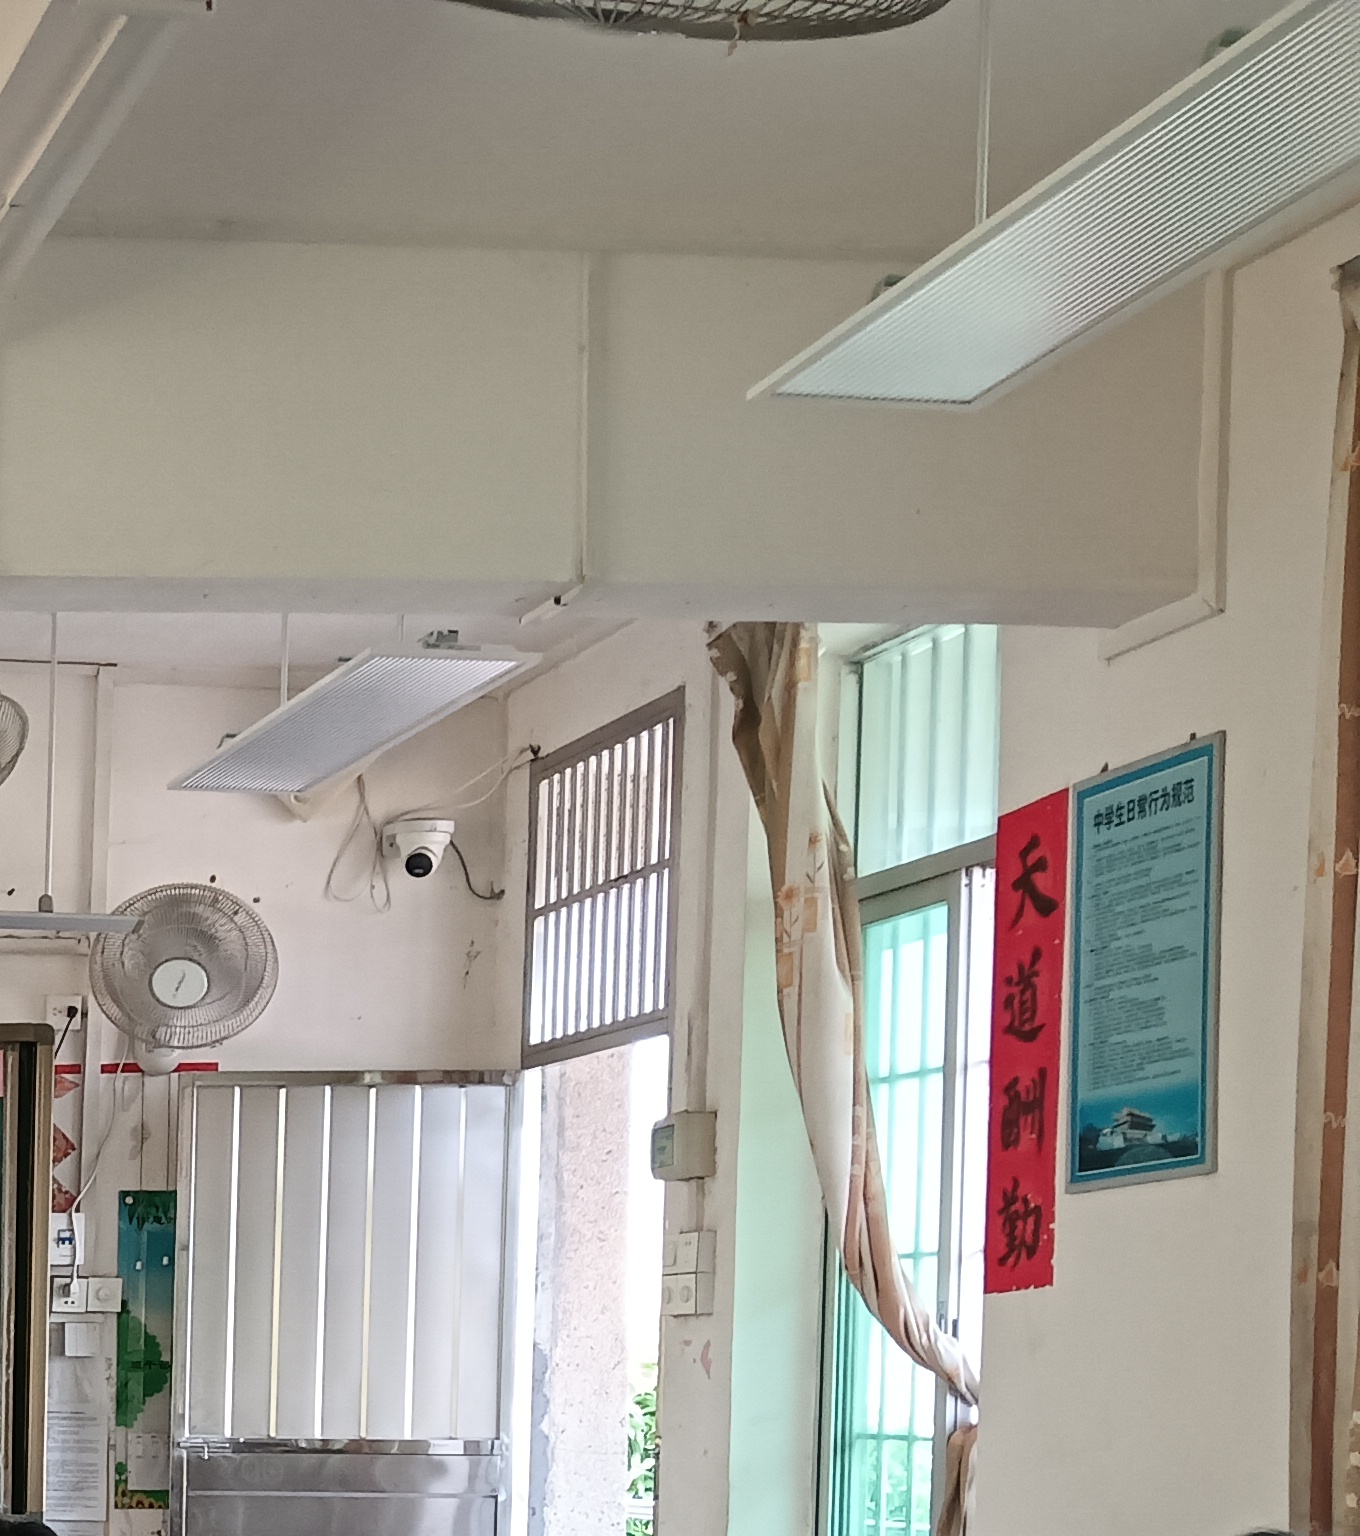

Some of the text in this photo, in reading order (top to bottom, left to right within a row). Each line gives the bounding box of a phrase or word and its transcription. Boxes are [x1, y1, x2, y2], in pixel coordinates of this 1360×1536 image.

[1093, 777, 1195, 834] 中学生日常行为规范
[997, 834, 1060, 1271] 天道酬勤
